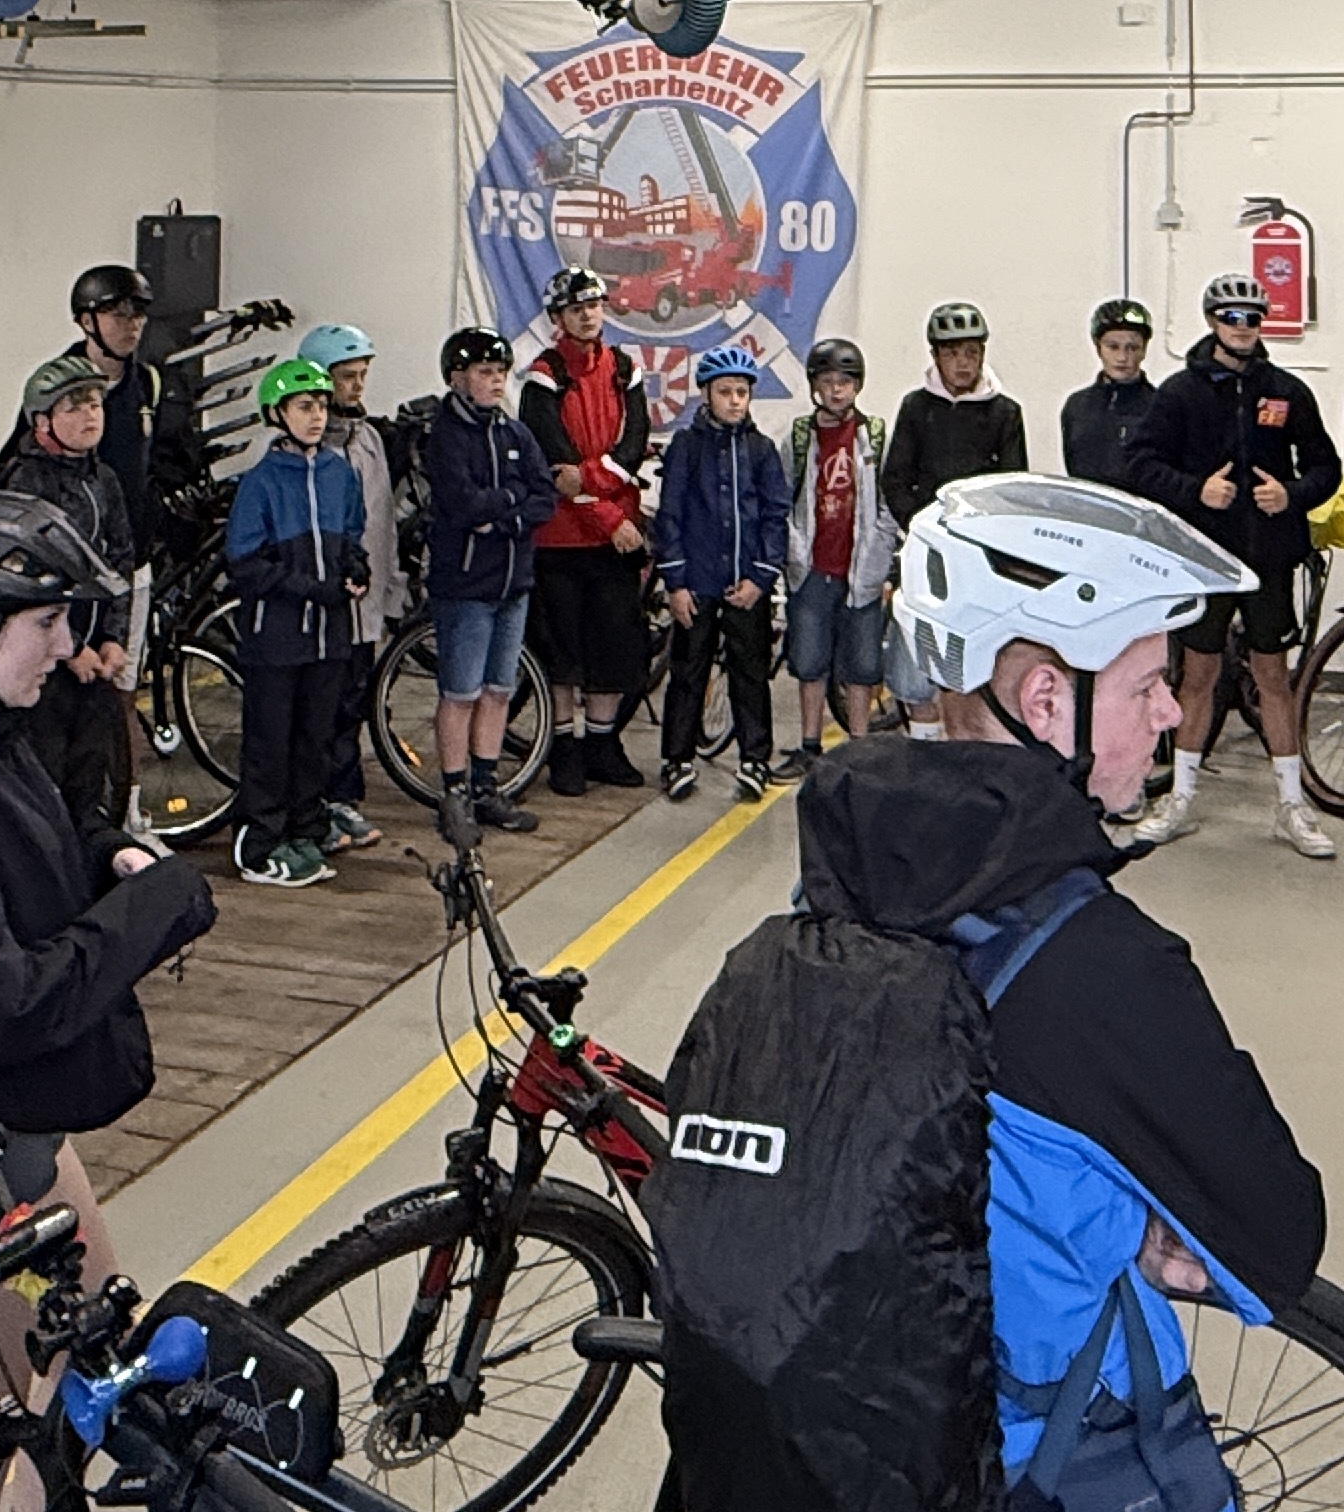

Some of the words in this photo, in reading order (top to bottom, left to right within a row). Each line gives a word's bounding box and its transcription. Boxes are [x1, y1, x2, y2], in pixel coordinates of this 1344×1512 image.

[574, 75, 755, 119] Scharbeutz
[479, 186, 546, 241] FFS
[778, 200, 836, 252] 80
